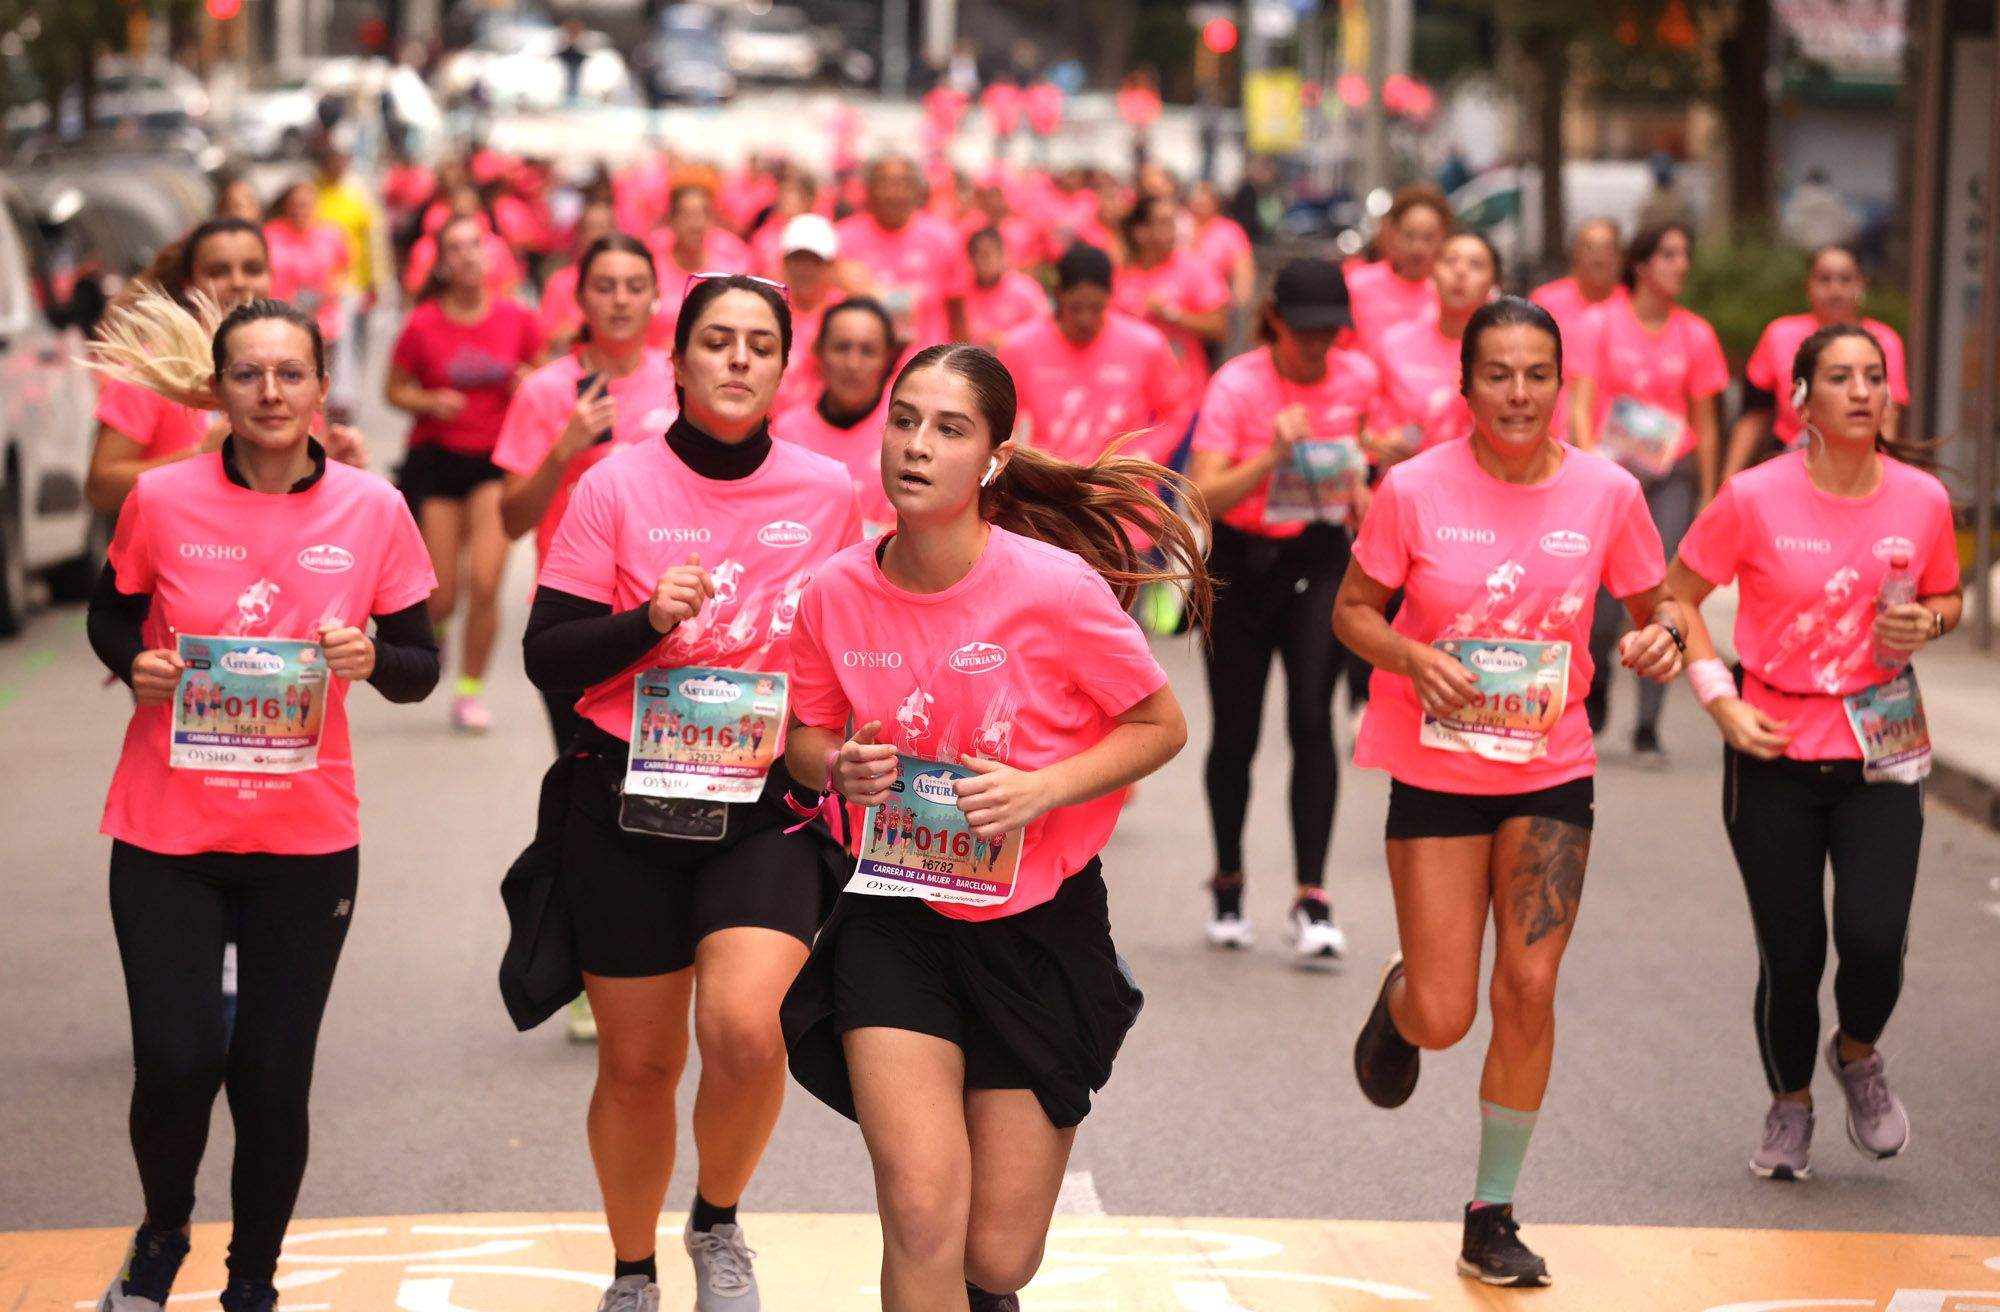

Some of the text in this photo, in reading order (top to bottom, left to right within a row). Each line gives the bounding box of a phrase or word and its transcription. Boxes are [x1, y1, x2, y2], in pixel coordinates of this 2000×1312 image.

[649, 527, 711, 543] OYSHO
[1436, 526, 1496, 545] OYSHO
[180, 543, 247, 561] OYSHO
[843, 650, 902, 668] OYSHO
[953, 653, 1003, 667] ASTURIANA
[684, 686, 738, 698] ASTURIANA
[224, 696, 280, 720] 016
[682, 724, 734, 748] 016
[188, 749, 236, 763] OYSHO
[916, 778, 958, 798] ASTURI
[914, 826, 971, 857] 016
[921, 858, 954, 874] 16782
[866, 880, 914, 893] OYSHO
[872, 864, 998, 892] CARRERA DE LA MUJER BARCELONA
